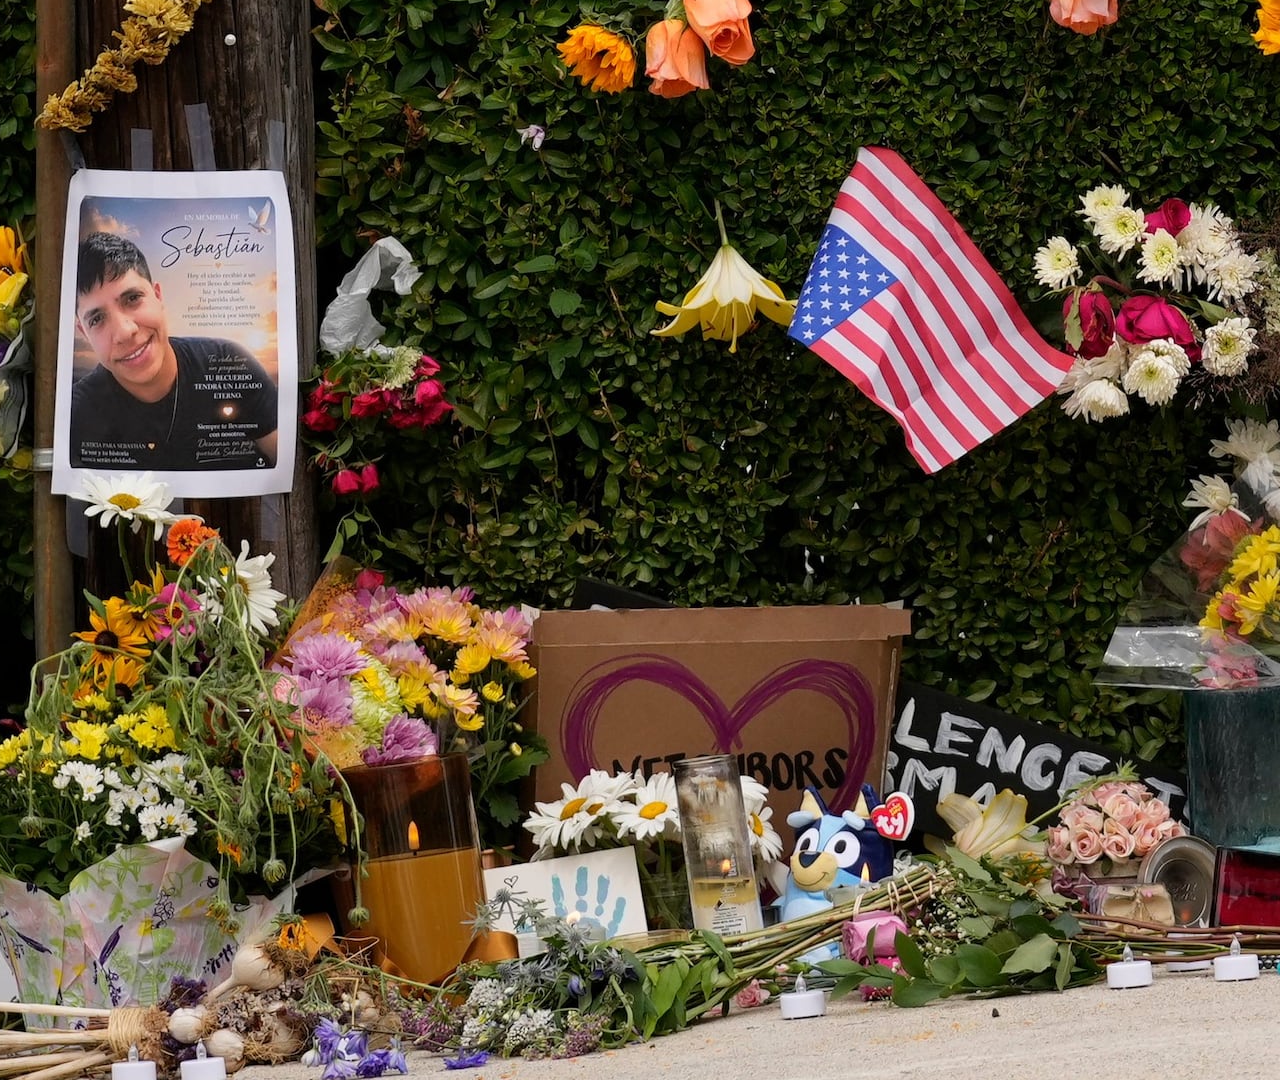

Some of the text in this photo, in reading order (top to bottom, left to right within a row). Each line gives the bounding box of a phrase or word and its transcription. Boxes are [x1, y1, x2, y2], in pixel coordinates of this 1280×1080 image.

[161, 225, 265, 268] Sebastián
[194, 382, 222, 390] TENDRÁ
[197, 423, 221, 431] Siempre
[894, 697, 1111, 801] LENCE
[876, 812, 905, 836] ty
